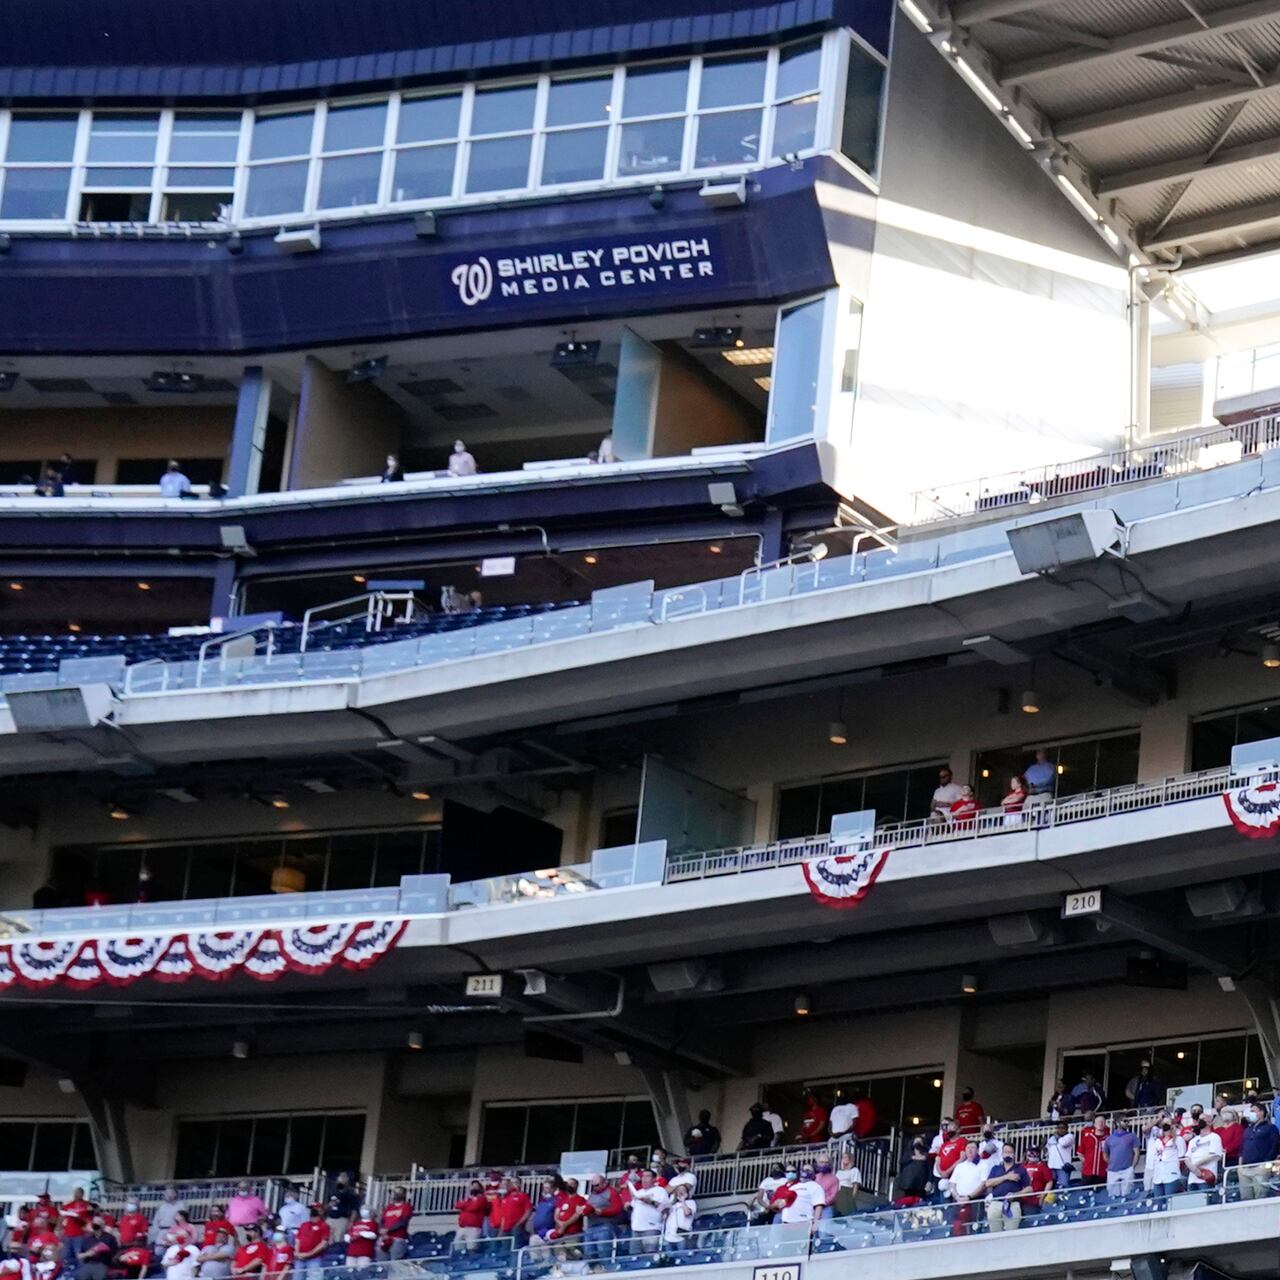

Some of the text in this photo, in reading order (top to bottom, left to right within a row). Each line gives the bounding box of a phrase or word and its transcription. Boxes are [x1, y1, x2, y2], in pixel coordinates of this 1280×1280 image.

[497, 238, 711, 277] SHIRLEY POVICH
[501, 261, 715, 297] MEDIA CENTER
[1071, 895, 1096, 911] 210
[473, 979, 494, 992] 211
